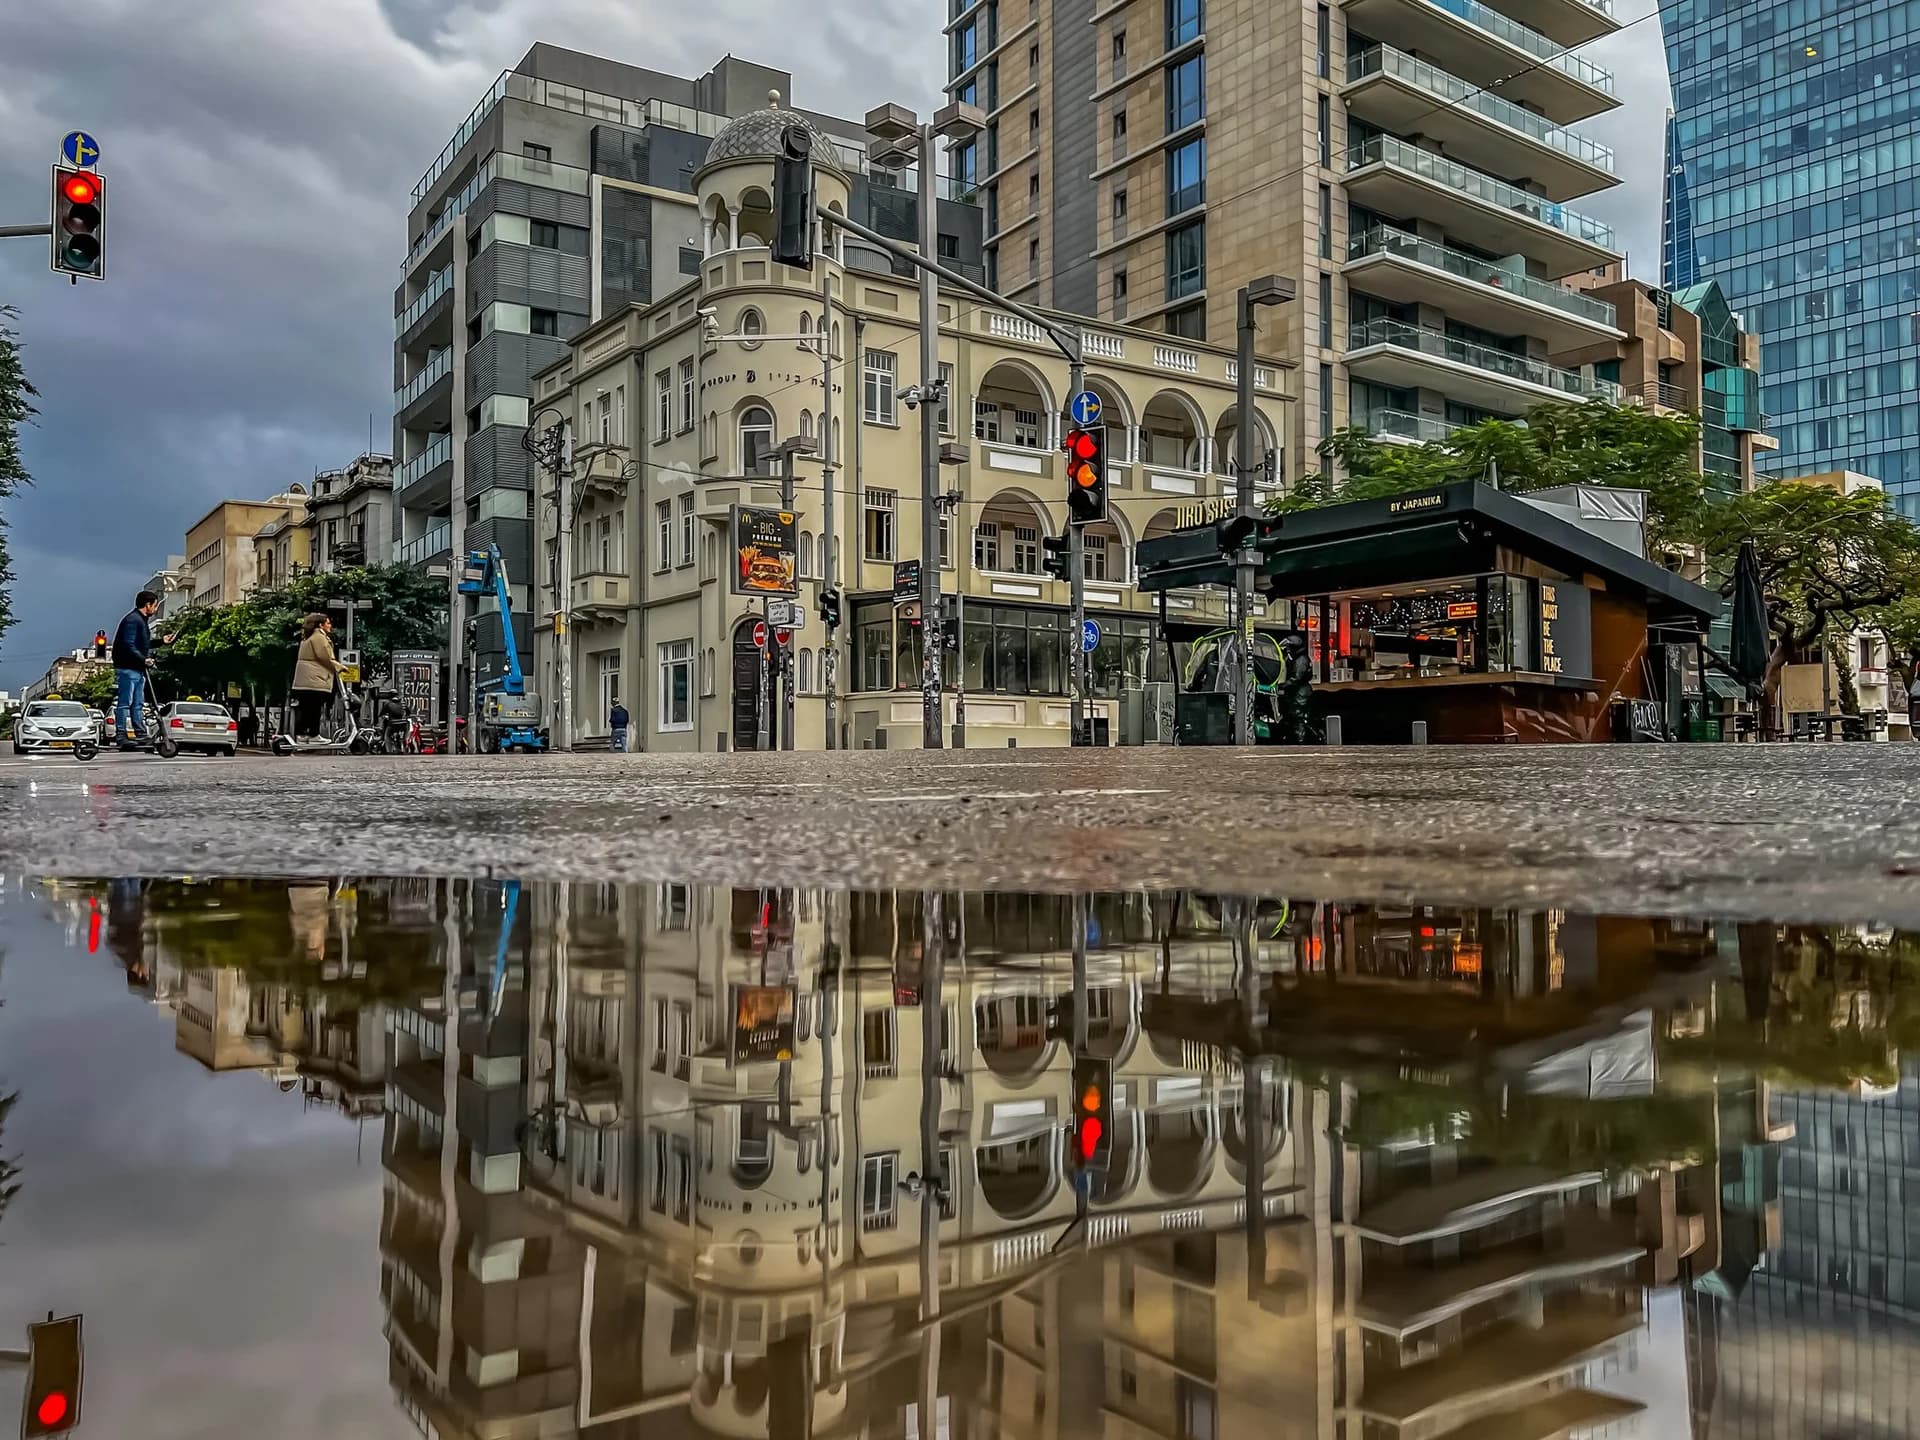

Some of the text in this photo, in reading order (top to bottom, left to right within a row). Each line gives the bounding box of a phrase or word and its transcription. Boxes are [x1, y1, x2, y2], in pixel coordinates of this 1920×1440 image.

[1390, 495, 1442, 512] BY JAPANIKA
[1175, 503, 1203, 529] JIRO
[760, 522, 775, 535] BIG
[1542, 585, 1556, 602] THIS
[1542, 603, 1559, 620] MUST
[1543, 621, 1551, 637] BE
[1543, 638, 1555, 655] THE
[404, 681, 430, 696] 21/22
